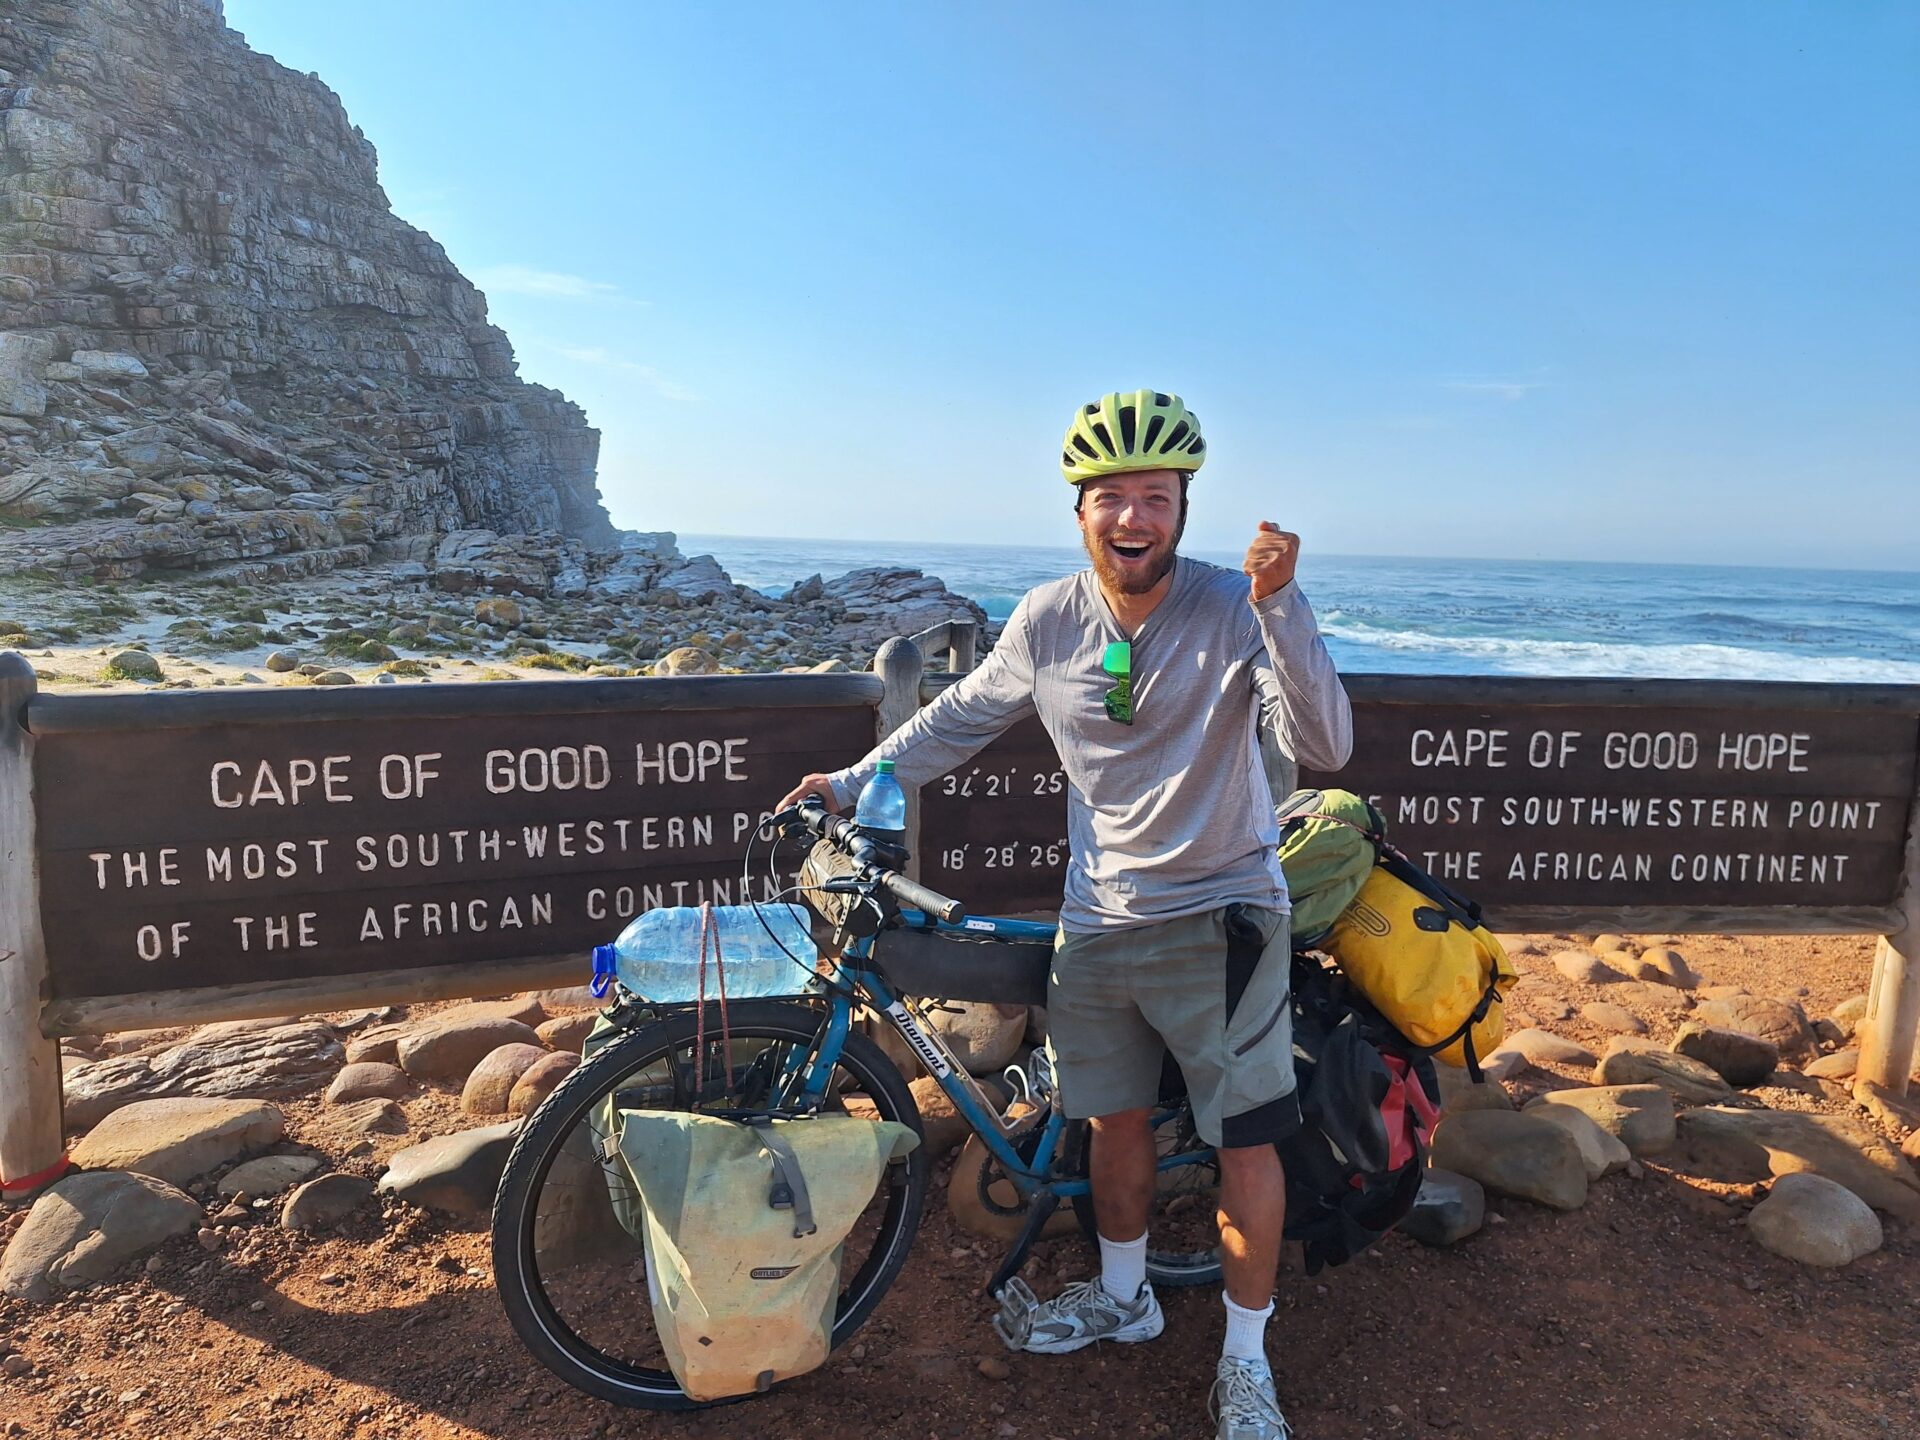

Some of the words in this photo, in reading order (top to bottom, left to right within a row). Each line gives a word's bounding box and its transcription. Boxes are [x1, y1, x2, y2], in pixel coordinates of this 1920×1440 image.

[211, 754, 354, 809] CAPE
[379, 752, 443, 800] OF
[485, 743, 612, 795] GOOD
[636, 737, 750, 787] HOPE
[1410, 728, 1509, 768] CAPE
[1528, 730, 1582, 769] OF
[1603, 731, 1699, 770] GOOD
[1717, 732, 1811, 772] HOPE
[1398, 795, 1485, 825] MOST
[1501, 796, 1769, 828] SOUTH-WESTERN
[1788, 800, 1881, 830] POINT
[88, 848, 181, 889] THE
[206, 839, 330, 883] MOST
[355, 814, 713, 872] SOUTH-WESTERN
[1422, 851, 1482, 880] THE
[1508, 852, 1652, 881] AFRICAN
[1670, 854, 1849, 883] CONTINENT
[136, 921, 192, 962] OF
[232, 912, 319, 951] THE
[359, 892, 553, 942] AFRICAN
[895, 1009, 945, 1071] Diamant
